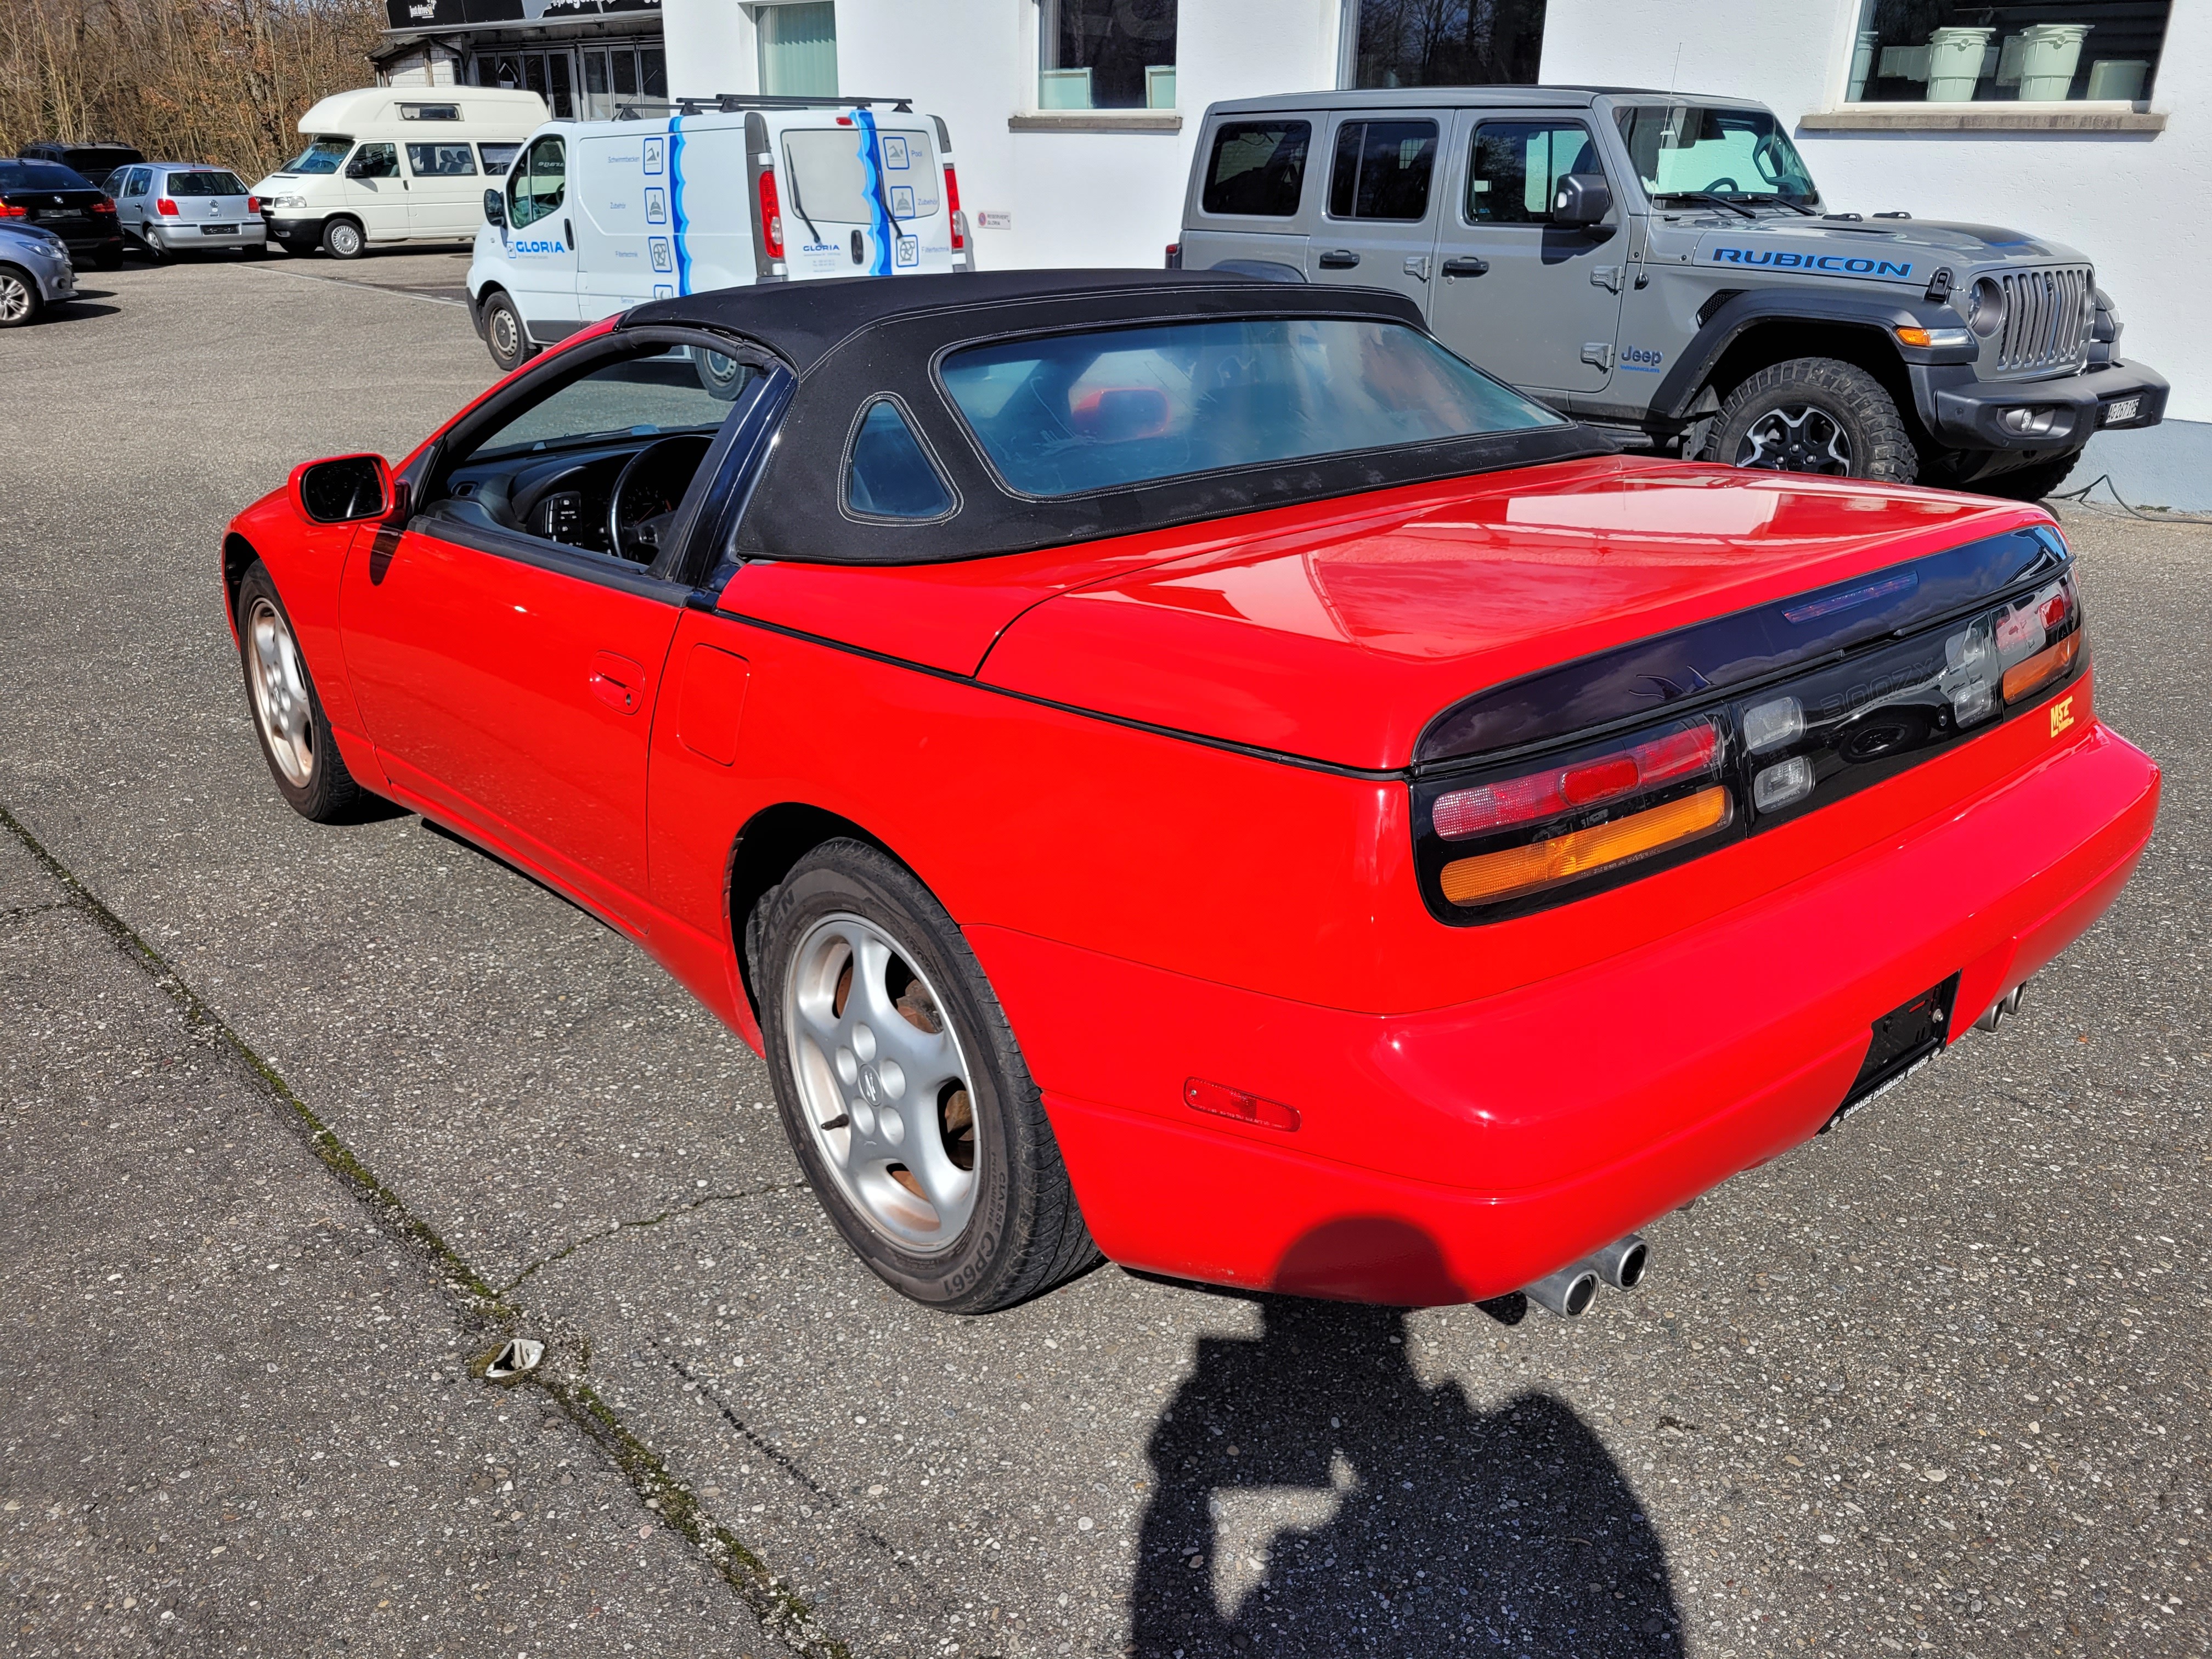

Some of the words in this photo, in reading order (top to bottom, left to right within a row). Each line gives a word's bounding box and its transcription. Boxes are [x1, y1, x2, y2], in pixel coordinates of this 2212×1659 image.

[516, 241, 565, 253] GLORIA
[1712, 247, 1913, 278] RUBICON
[1621, 345, 1663, 366] Jeep
[1820, 658, 1936, 720] 300ZX
[1843, 1093, 1873, 1119] GARAGE
[1872, 1071, 1905, 1100] DAMBACH
[1906, 1055, 1929, 1077] BRUGG
[943, 1231, 996, 1296] CP661
